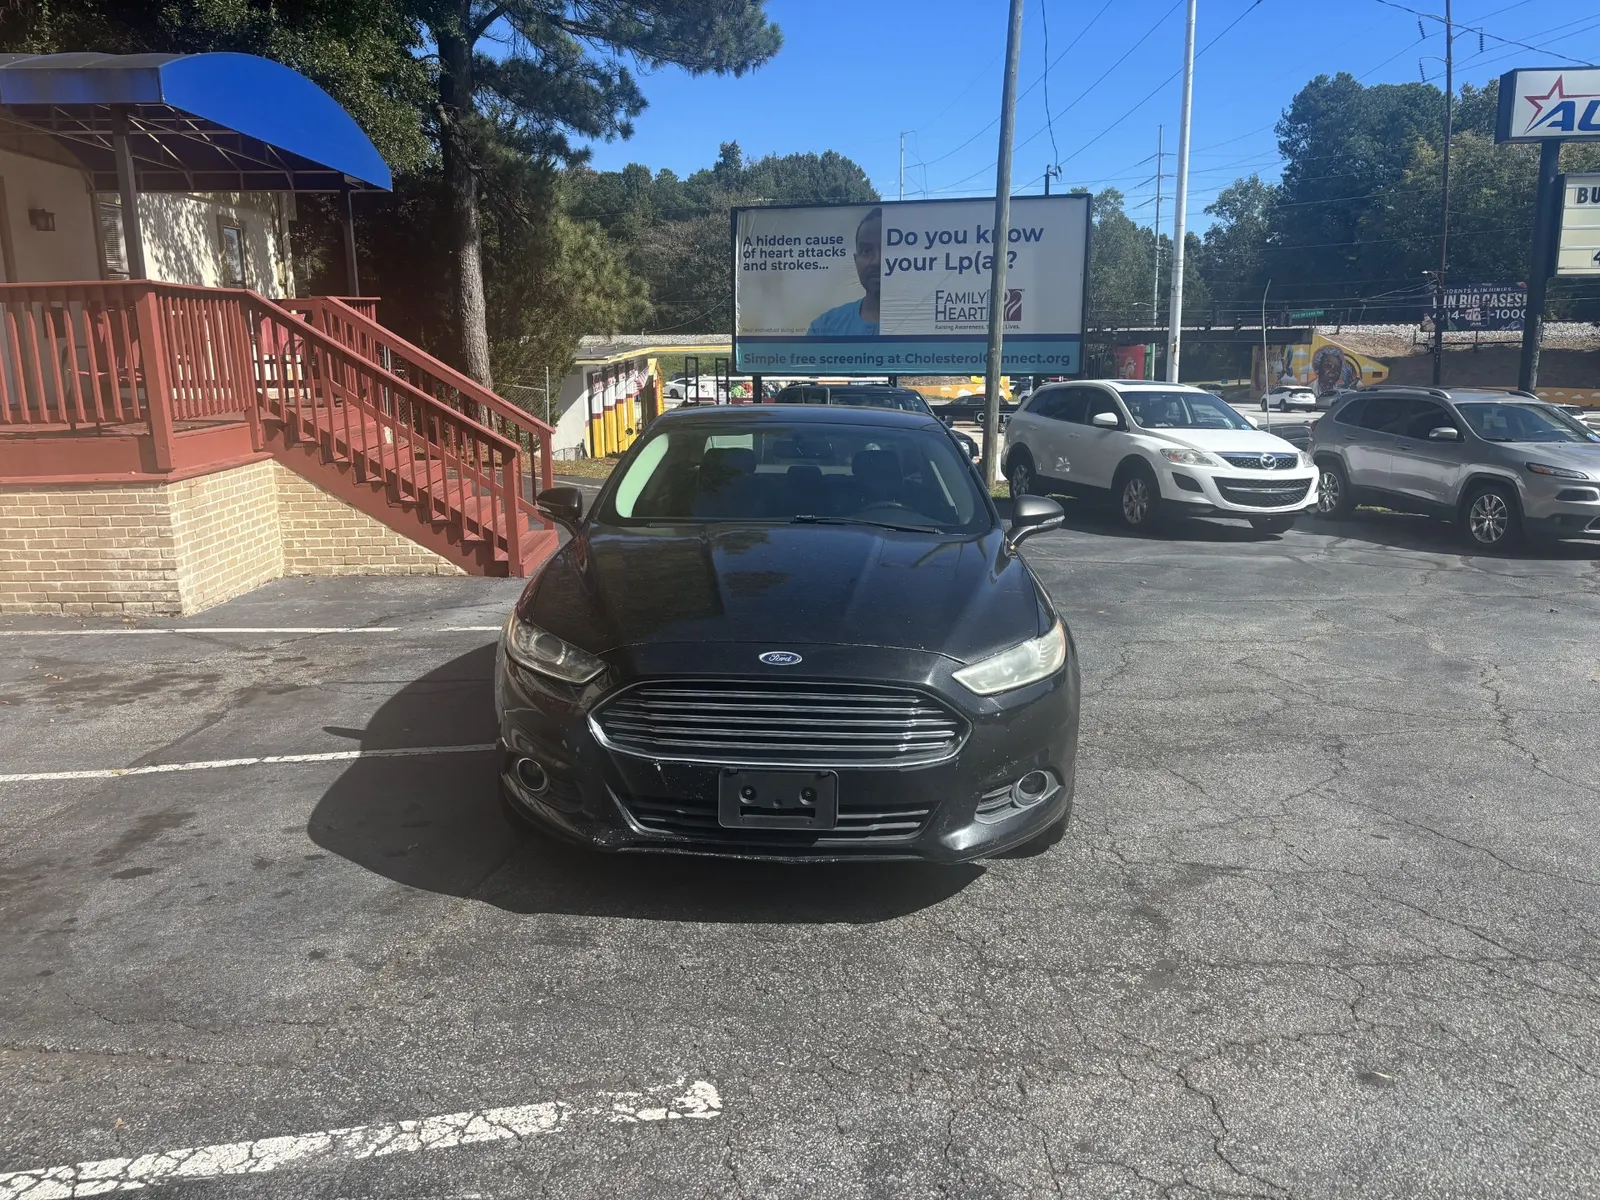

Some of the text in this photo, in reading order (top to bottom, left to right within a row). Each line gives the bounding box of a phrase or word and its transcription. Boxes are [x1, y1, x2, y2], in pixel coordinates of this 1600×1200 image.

[743, 235, 844, 246] A hidden cause
[886, 225, 1044, 250] Do you kow
[743, 246, 846, 259] of heart attacks
[743, 259, 829, 271] and strokes...
[884, 250, 1017, 276] your Lp(a?
[935, 290, 987, 304] FAMILY
[1459, 294, 1480, 308] BIG
[935, 304, 987, 320] HEART
[743, 352, 1070, 366] Simple free screening at Cholesterolnnect.org
[768, 654, 792, 662] Ford
